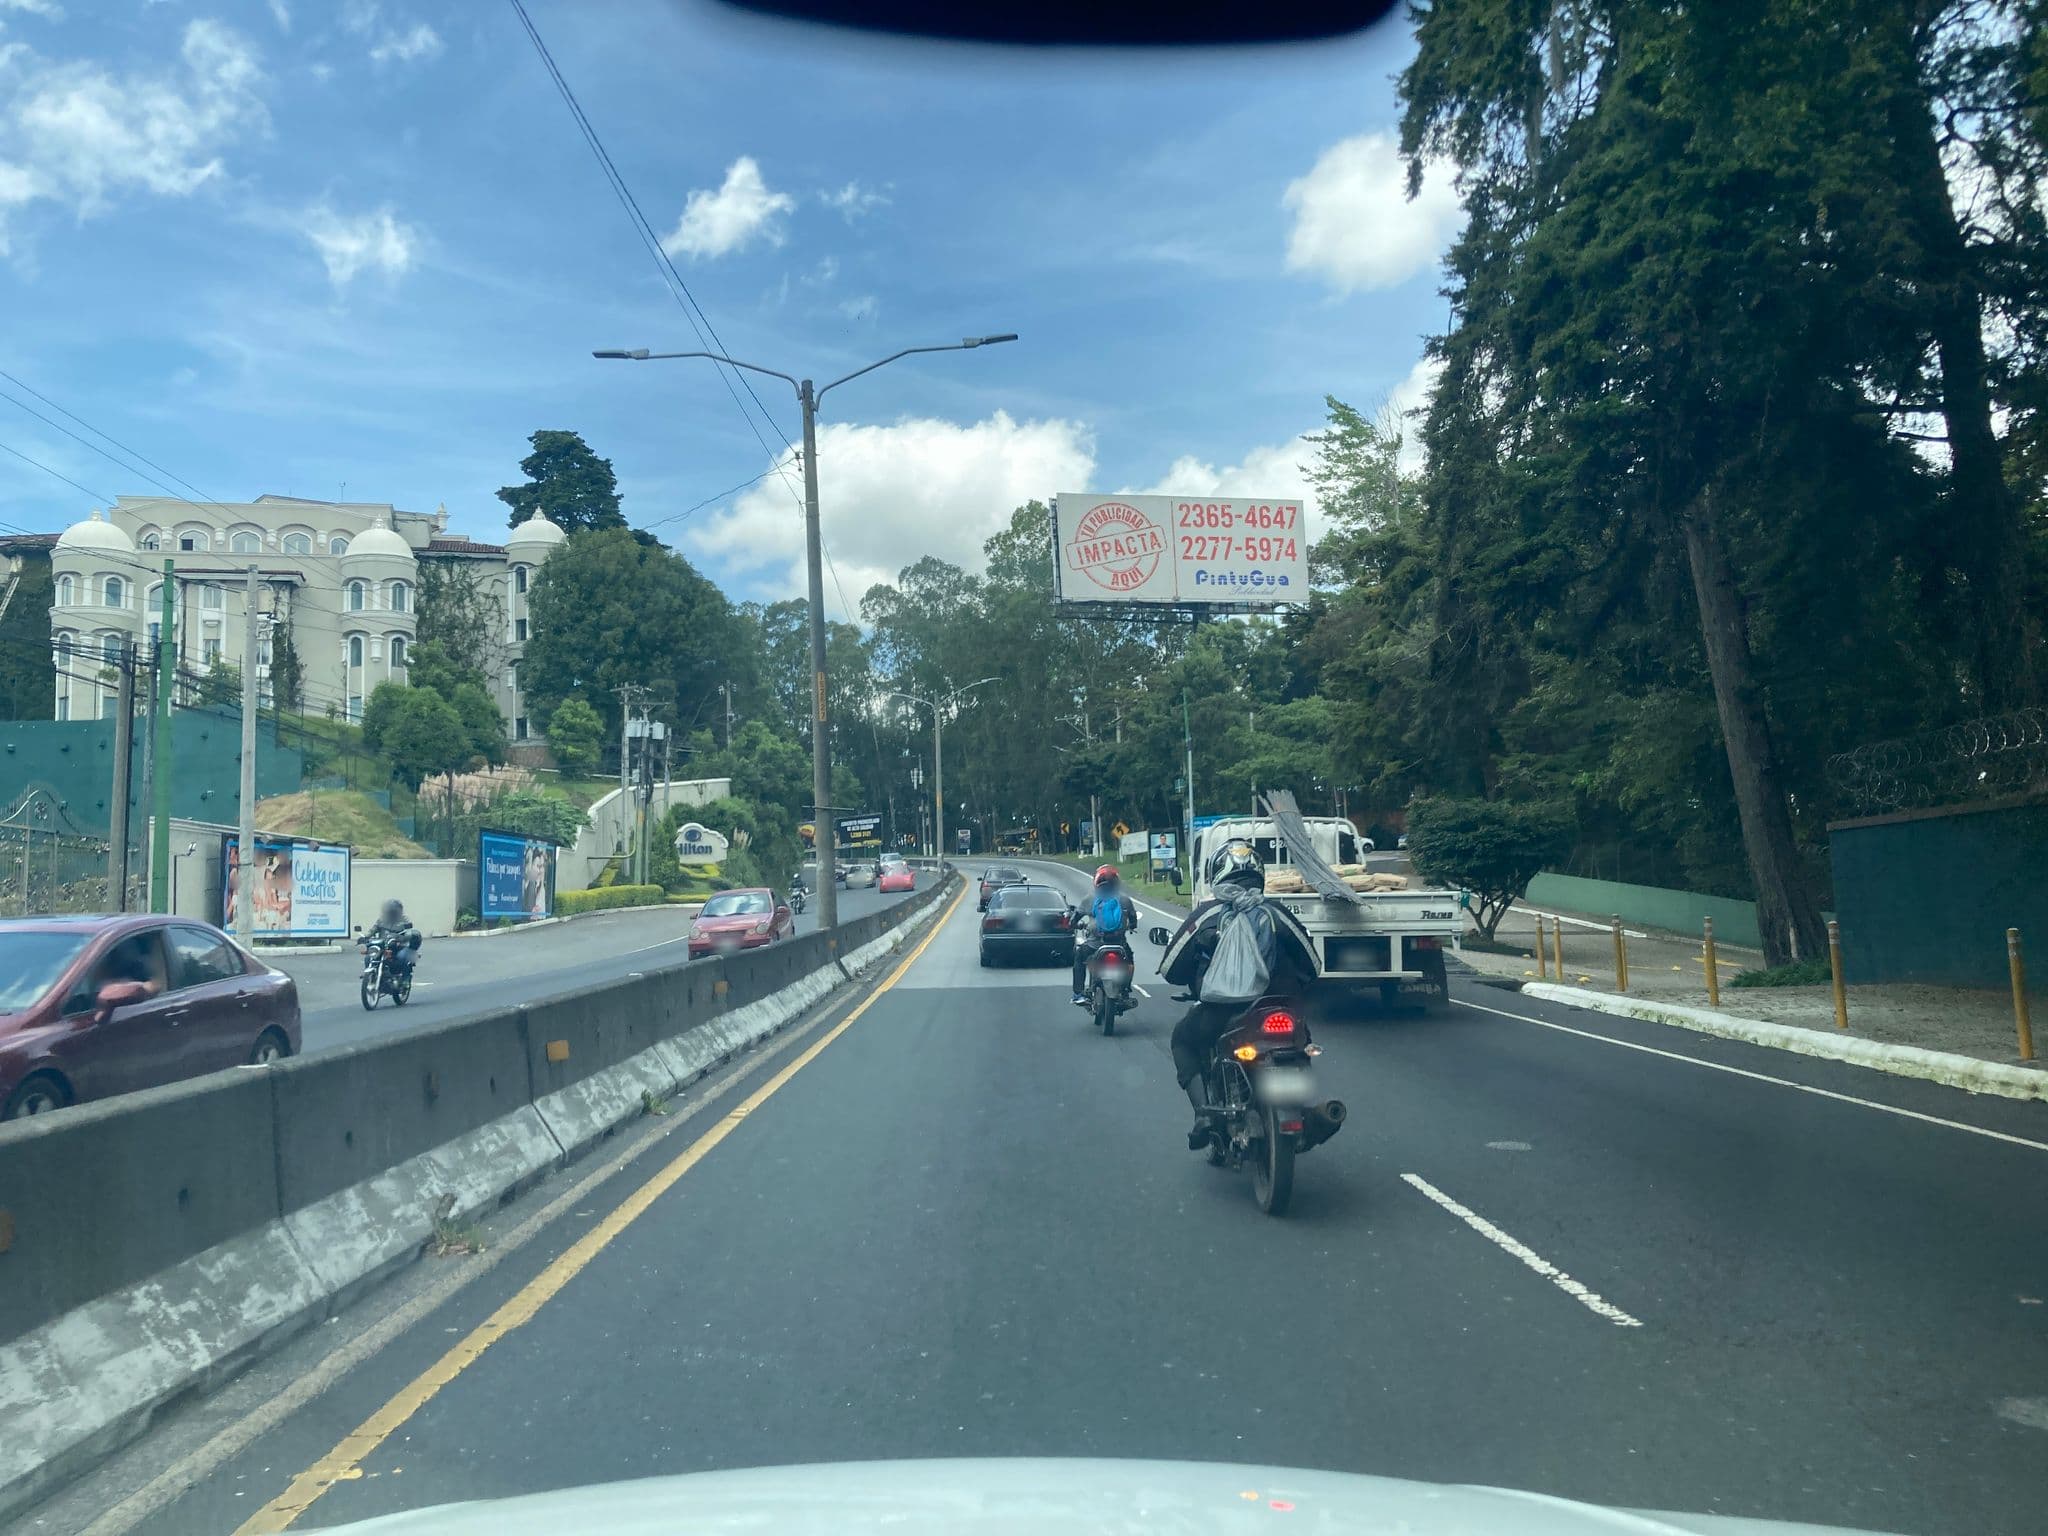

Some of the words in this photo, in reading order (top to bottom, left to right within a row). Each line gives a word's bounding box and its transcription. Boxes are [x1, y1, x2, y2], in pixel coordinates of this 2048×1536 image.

[1081, 525, 1095, 538] TU
[1089, 507, 1144, 529] PUBLICIDAD
[1178, 503, 1297, 529] 2365-4647
[1076, 531, 1162, 565] IMPACTA
[1180, 535, 1297, 562] 2277-5974
[1195, 569, 1289, 586] PintuGua
[295, 860, 327, 882] Celebra
[328, 871, 342, 882] con
[300, 882, 336, 900] nosotros
